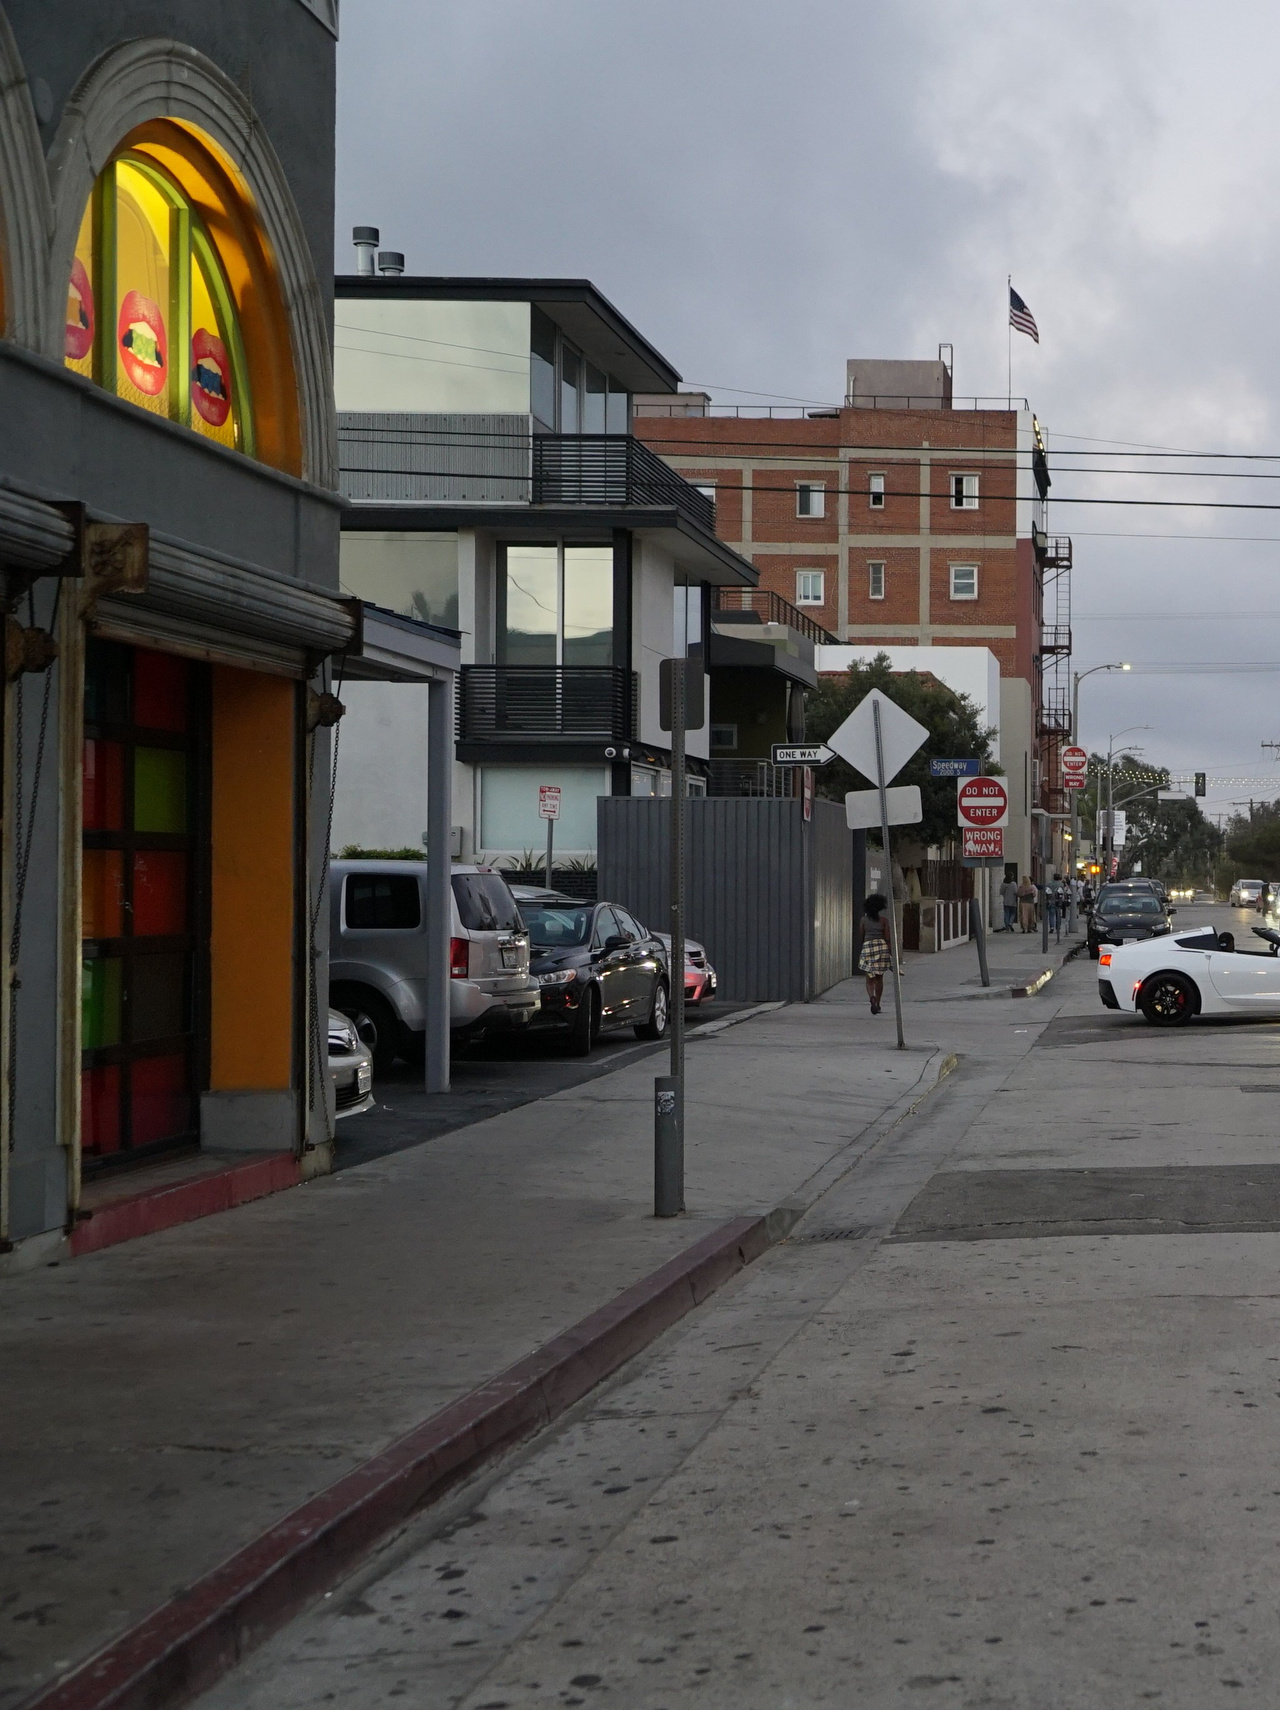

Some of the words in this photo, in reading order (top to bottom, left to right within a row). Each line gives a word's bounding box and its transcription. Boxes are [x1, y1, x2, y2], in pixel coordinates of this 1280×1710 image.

[779, 751, 797, 759] ONE
[932, 760, 967, 770] Speedway
[966, 787, 977, 795] DO
[983, 787, 999, 795] NOT
[970, 808, 998, 816] ENTER
[965, 831, 1001, 840] WRONG
[972, 843, 995, 853] WAY
